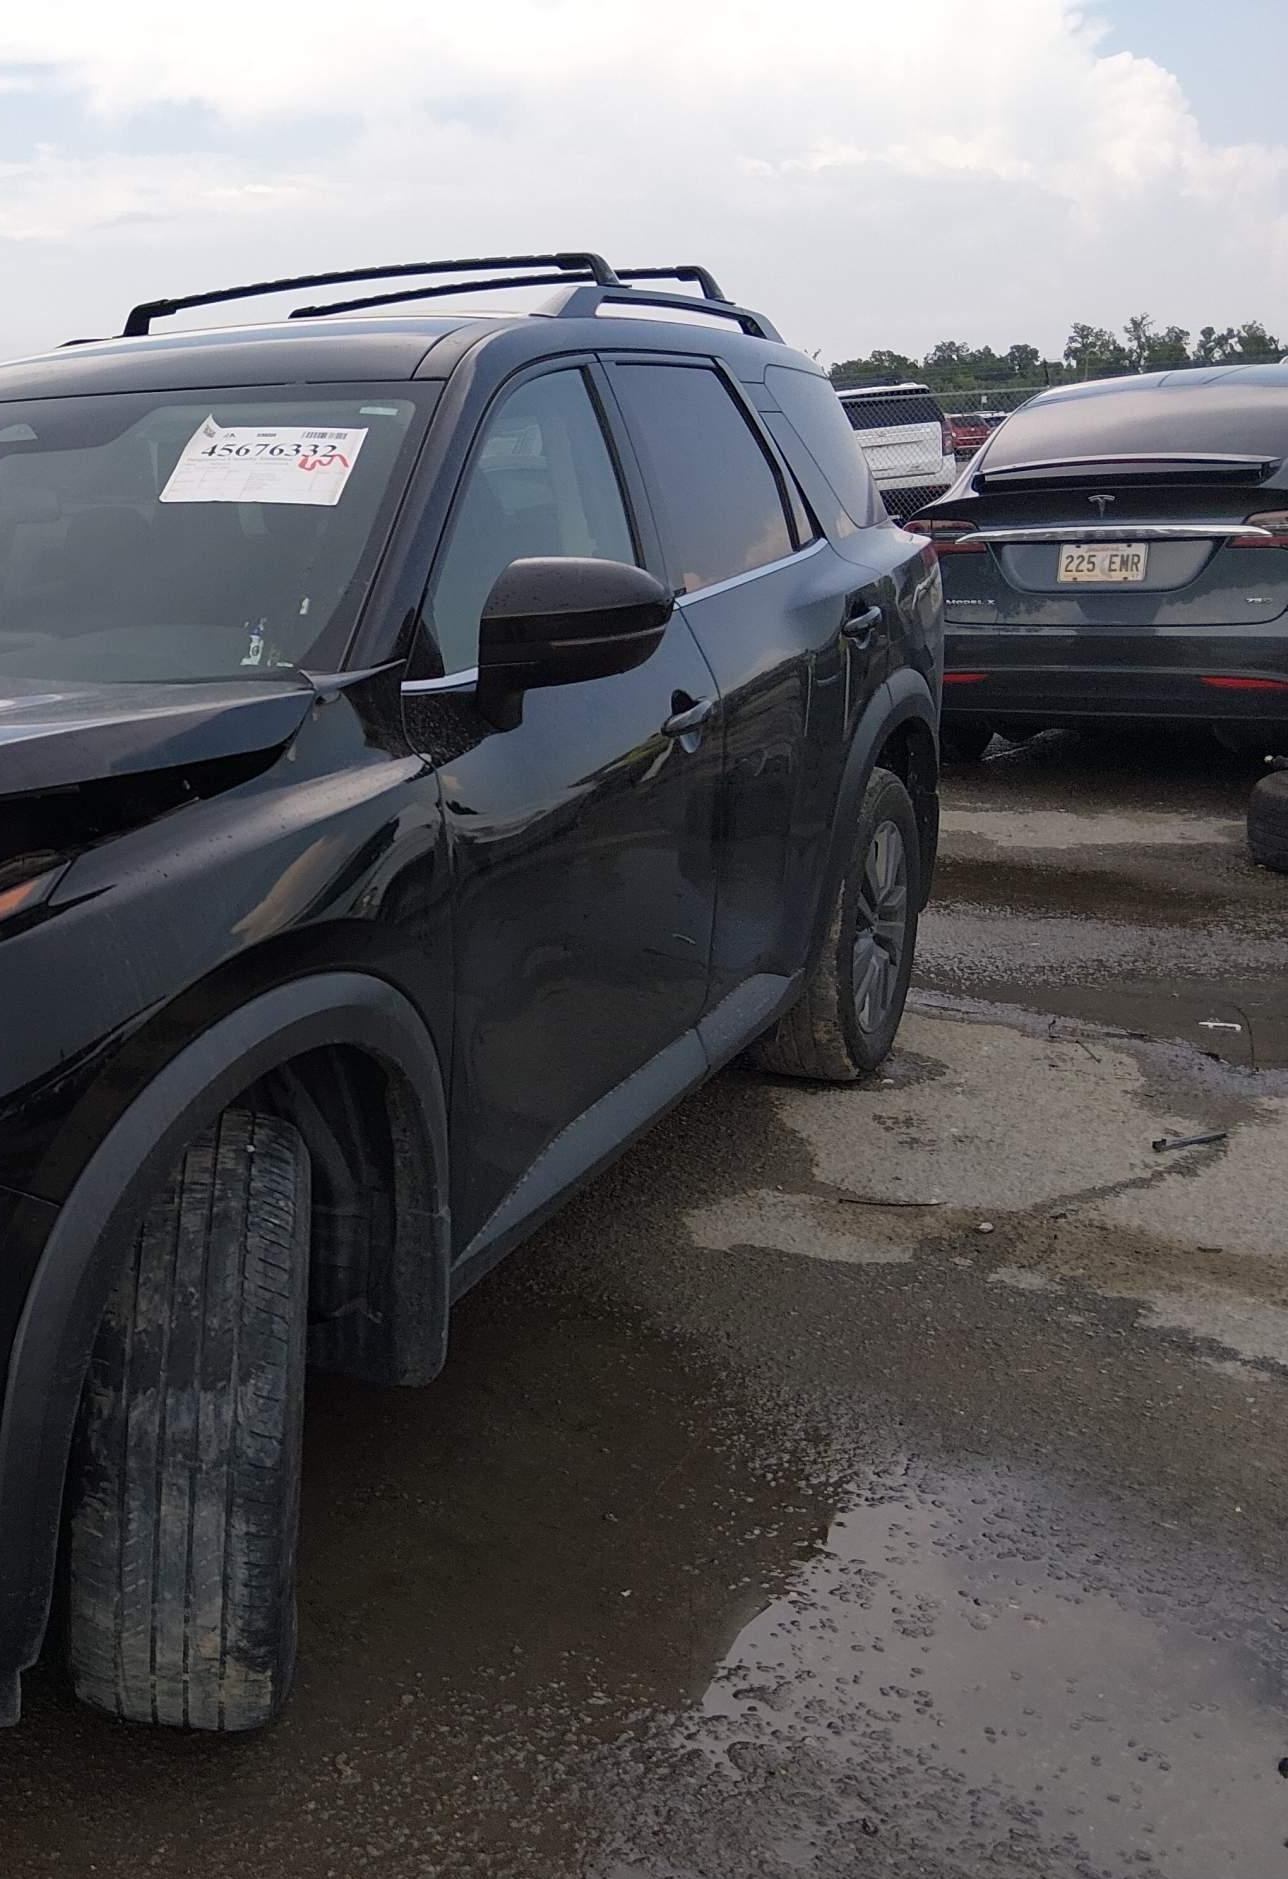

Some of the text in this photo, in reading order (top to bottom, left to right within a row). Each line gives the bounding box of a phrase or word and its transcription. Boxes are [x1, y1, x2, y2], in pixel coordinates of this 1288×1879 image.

[201, 443, 337, 457] 45676332
[1065, 554, 1141, 573] 225 EMR
